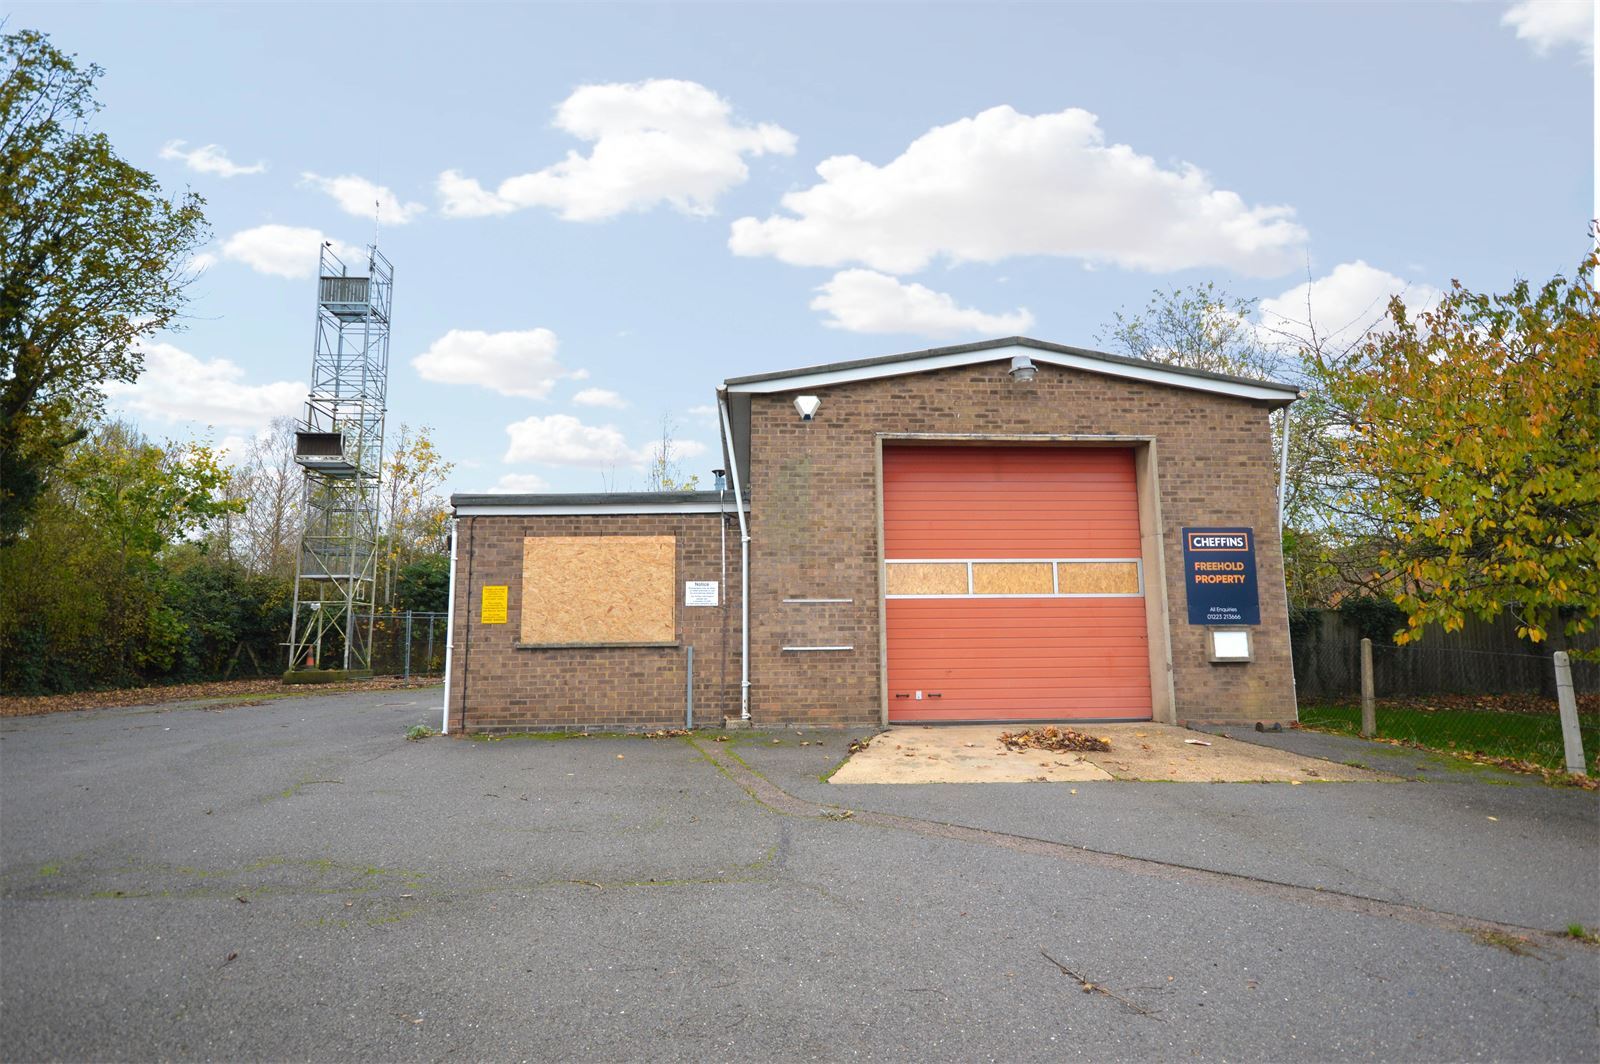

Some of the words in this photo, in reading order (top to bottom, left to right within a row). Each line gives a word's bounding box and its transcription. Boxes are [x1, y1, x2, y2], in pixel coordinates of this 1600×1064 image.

[1193, 537, 1244, 547] CHEFFINS
[1194, 562, 1244, 571] FREEHOLD
[1195, 575, 1245, 584] PROPERTY
